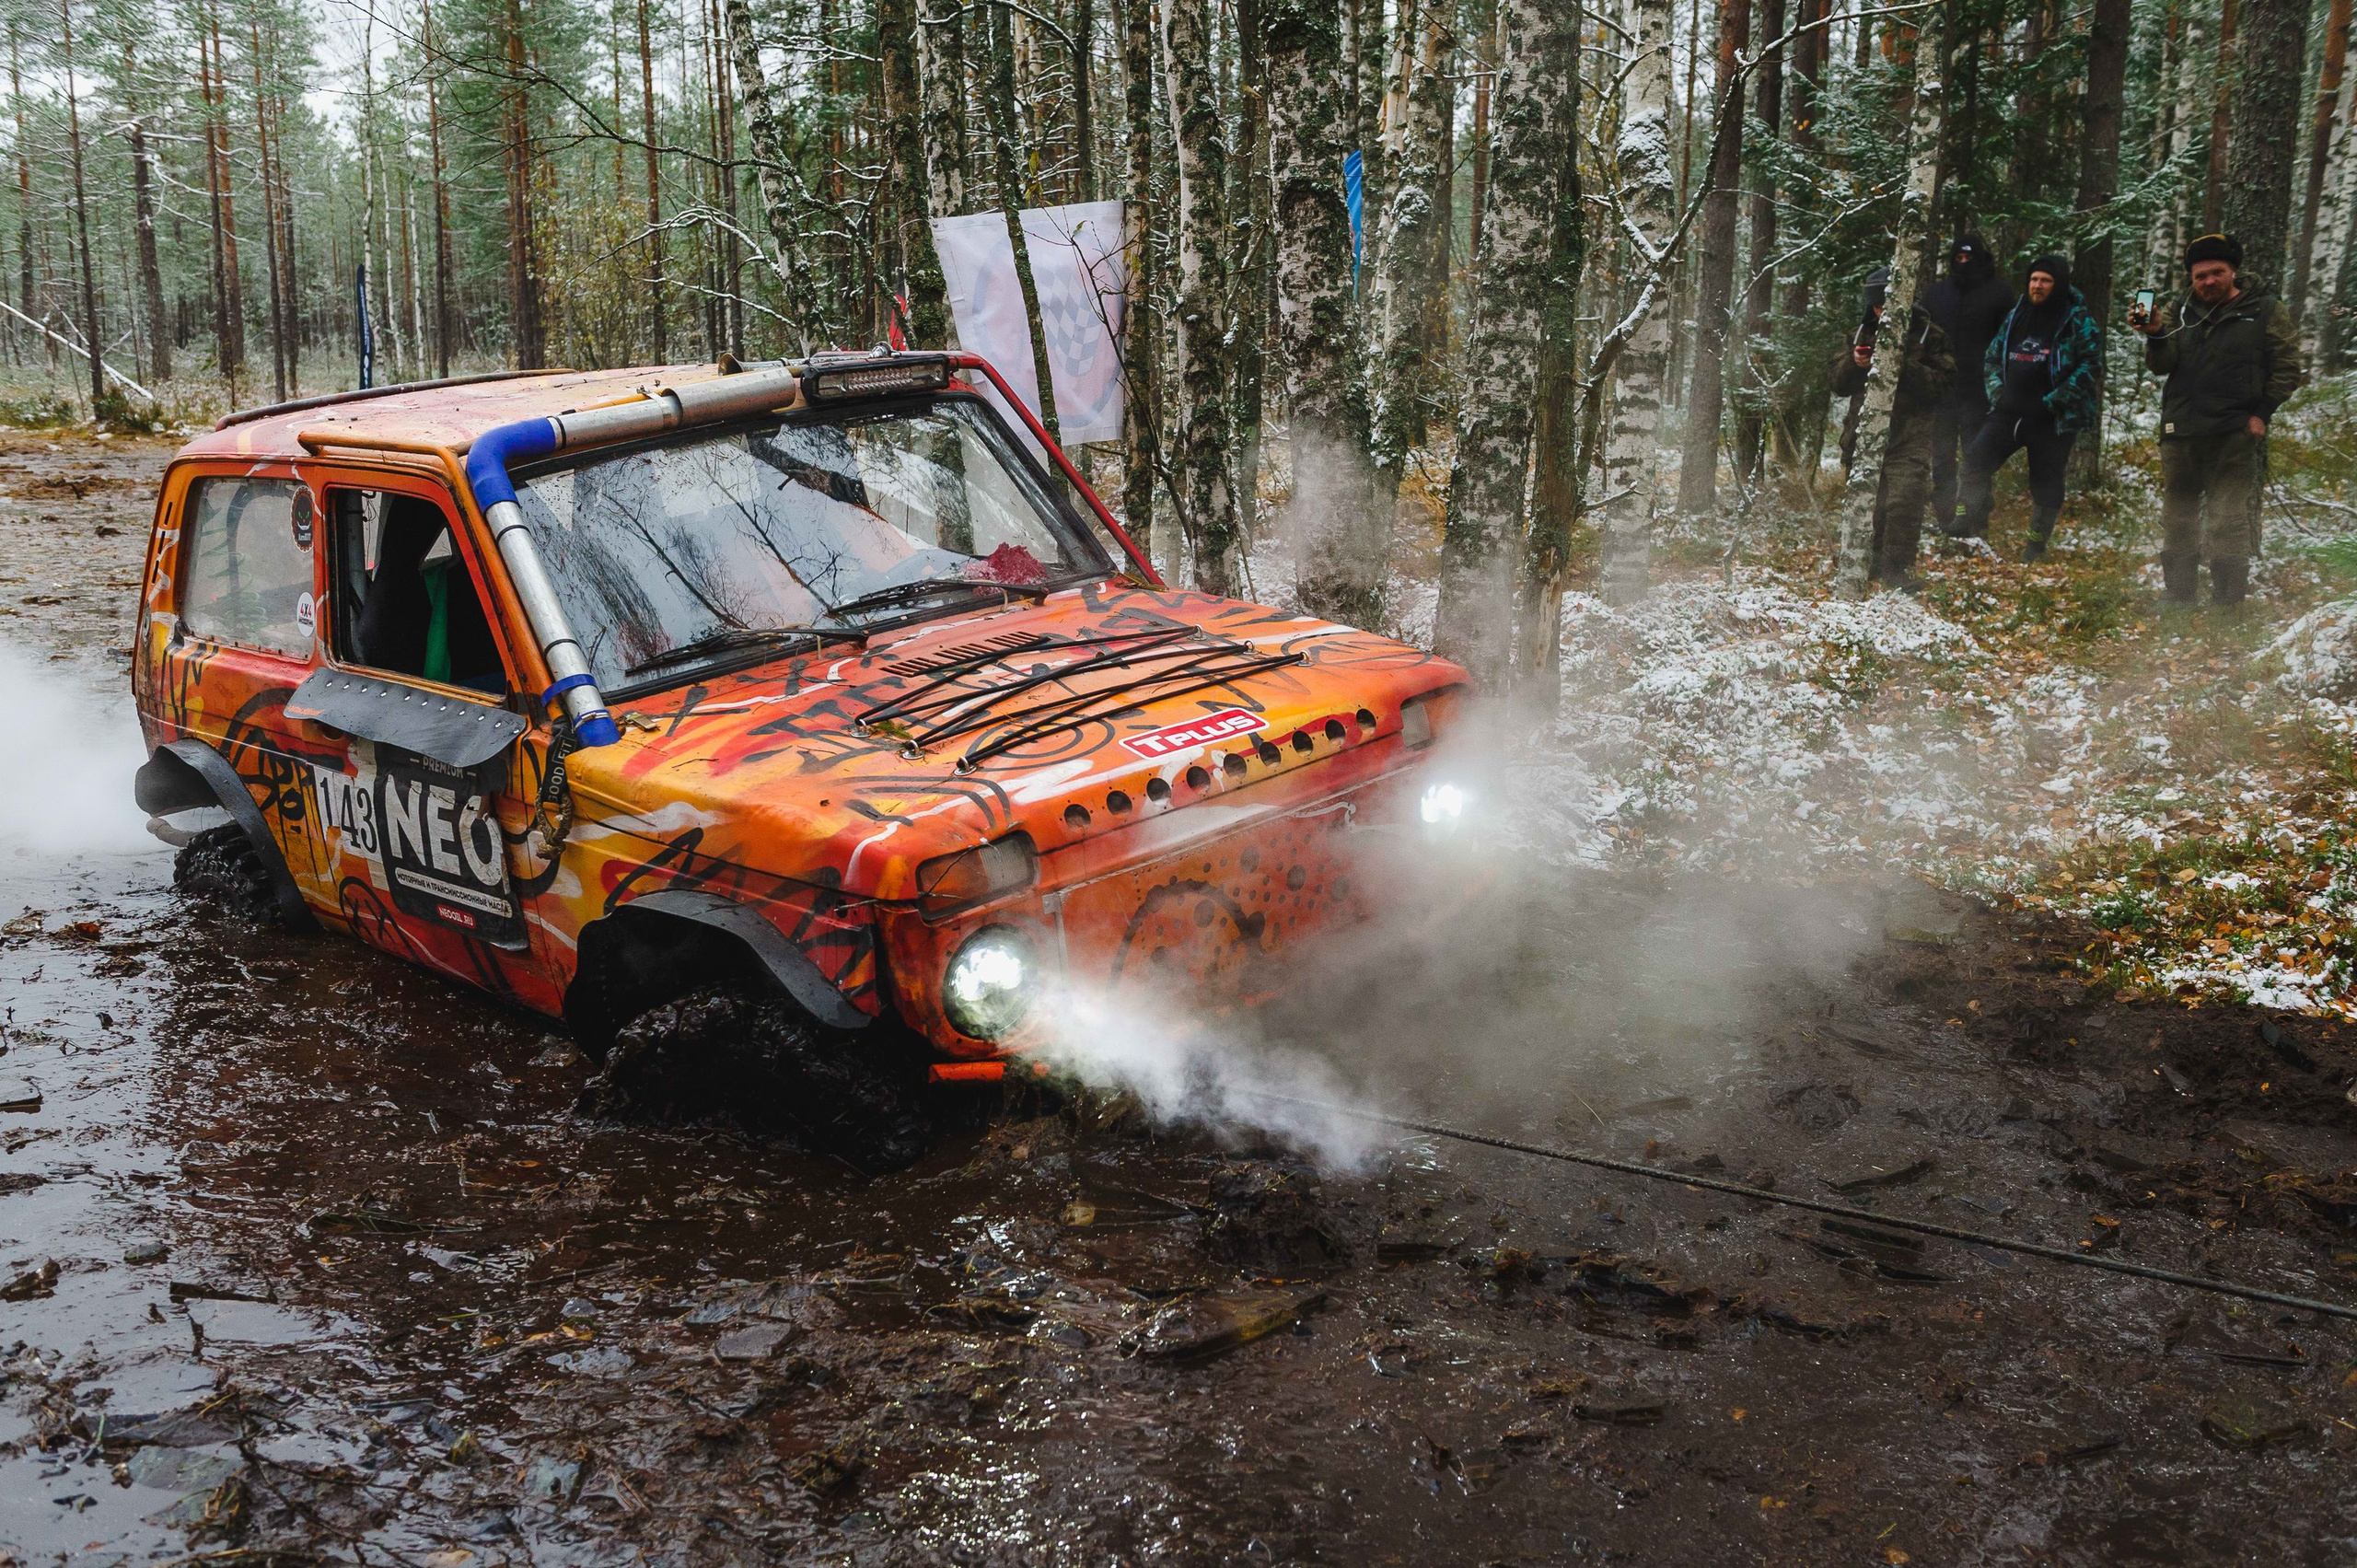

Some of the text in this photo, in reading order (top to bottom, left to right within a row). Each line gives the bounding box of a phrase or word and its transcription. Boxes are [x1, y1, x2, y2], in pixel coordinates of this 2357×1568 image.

[1132, 714, 1257, 752] TPLUS
[423, 755, 464, 779] PREMIUM
[319, 776, 377, 854] 143
[385, 773, 504, 887] NEO
[396, 872, 426, 886] МОТОРНЫЕ
[431, 882, 488, 907] ТРАНСМИССИОННЫЕ
